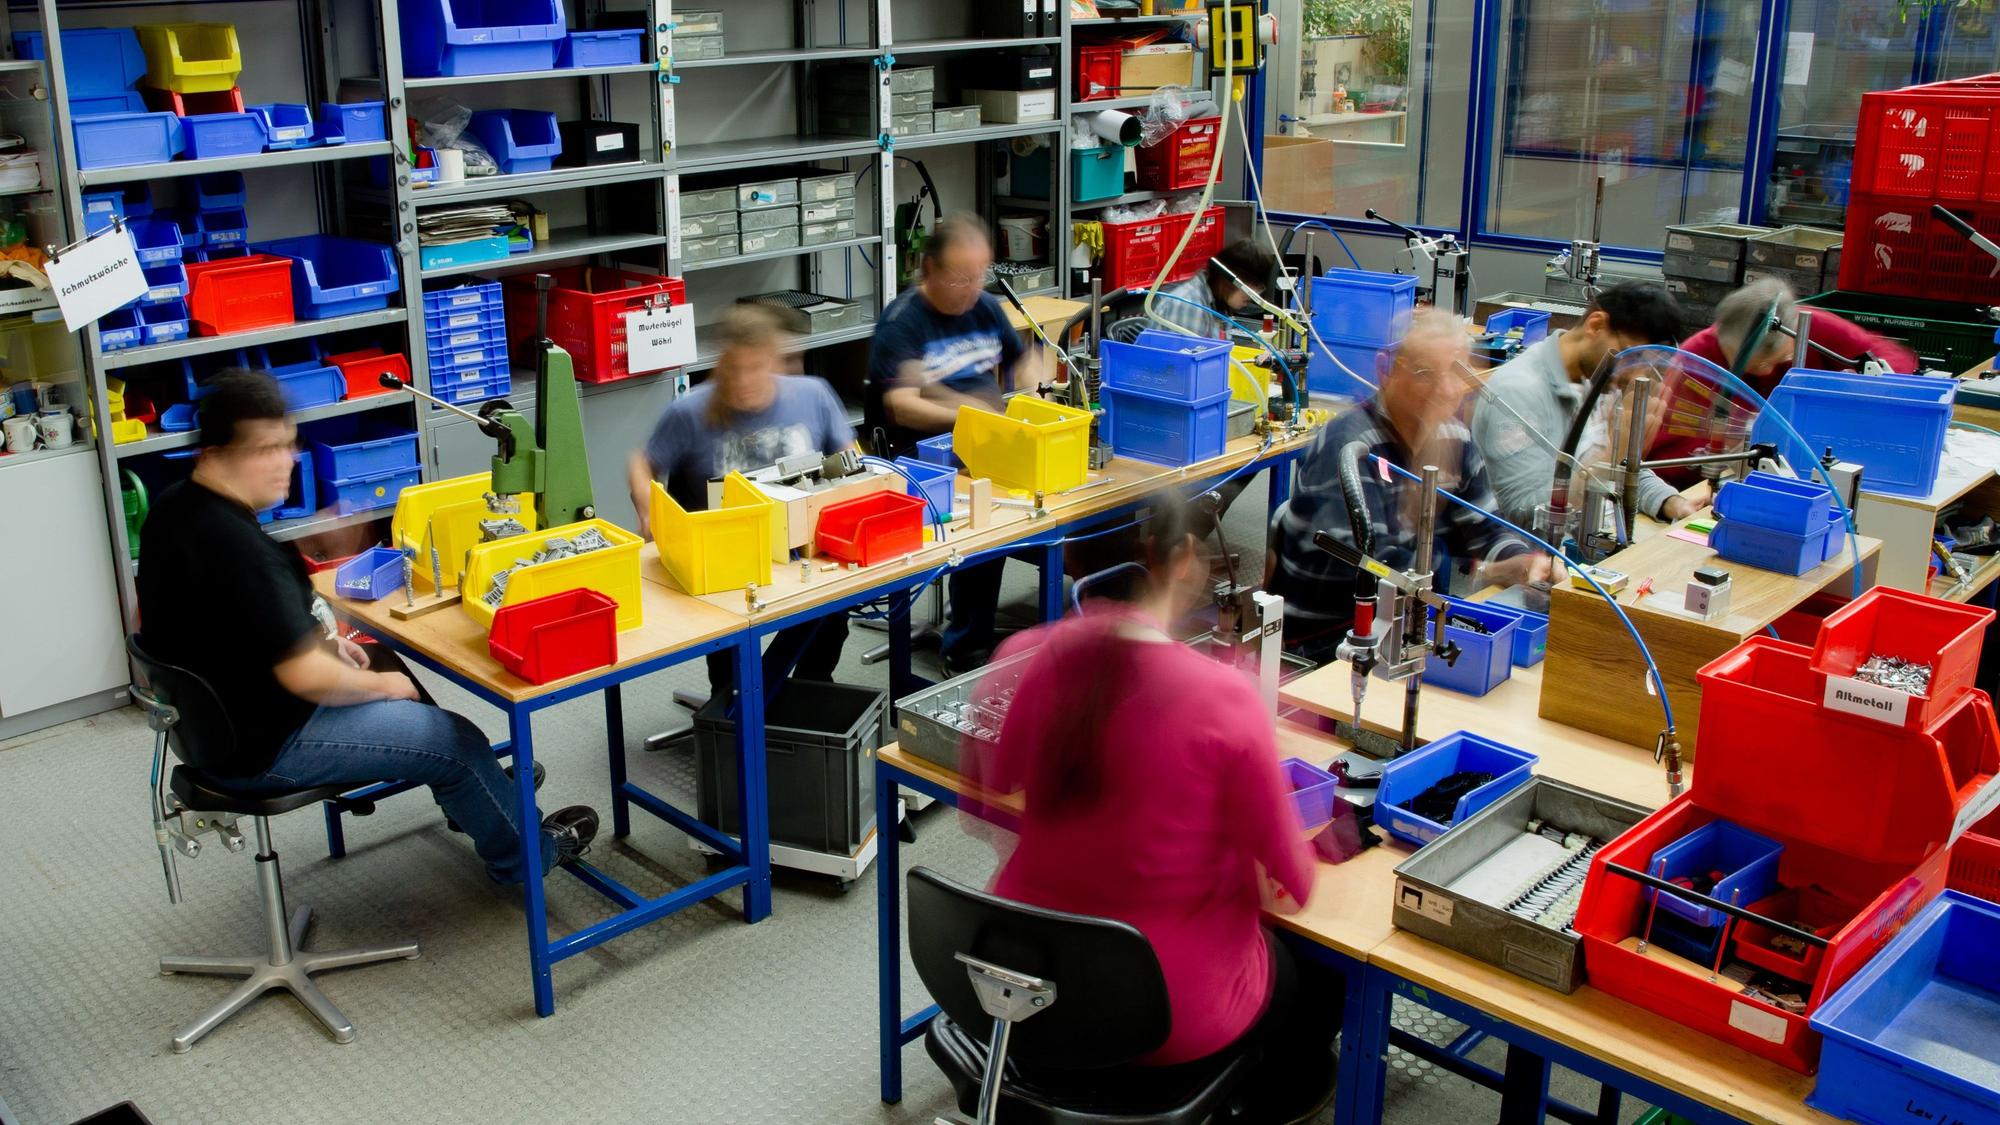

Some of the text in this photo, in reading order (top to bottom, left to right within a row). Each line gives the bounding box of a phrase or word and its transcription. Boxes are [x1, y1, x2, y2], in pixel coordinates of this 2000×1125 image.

[61, 256, 129, 297] Schmutzwäsche
[638, 318, 682, 332] Musterbügel
[651, 337, 672, 347] Wöhrl
[1835, 689, 1893, 712] Altmetall
